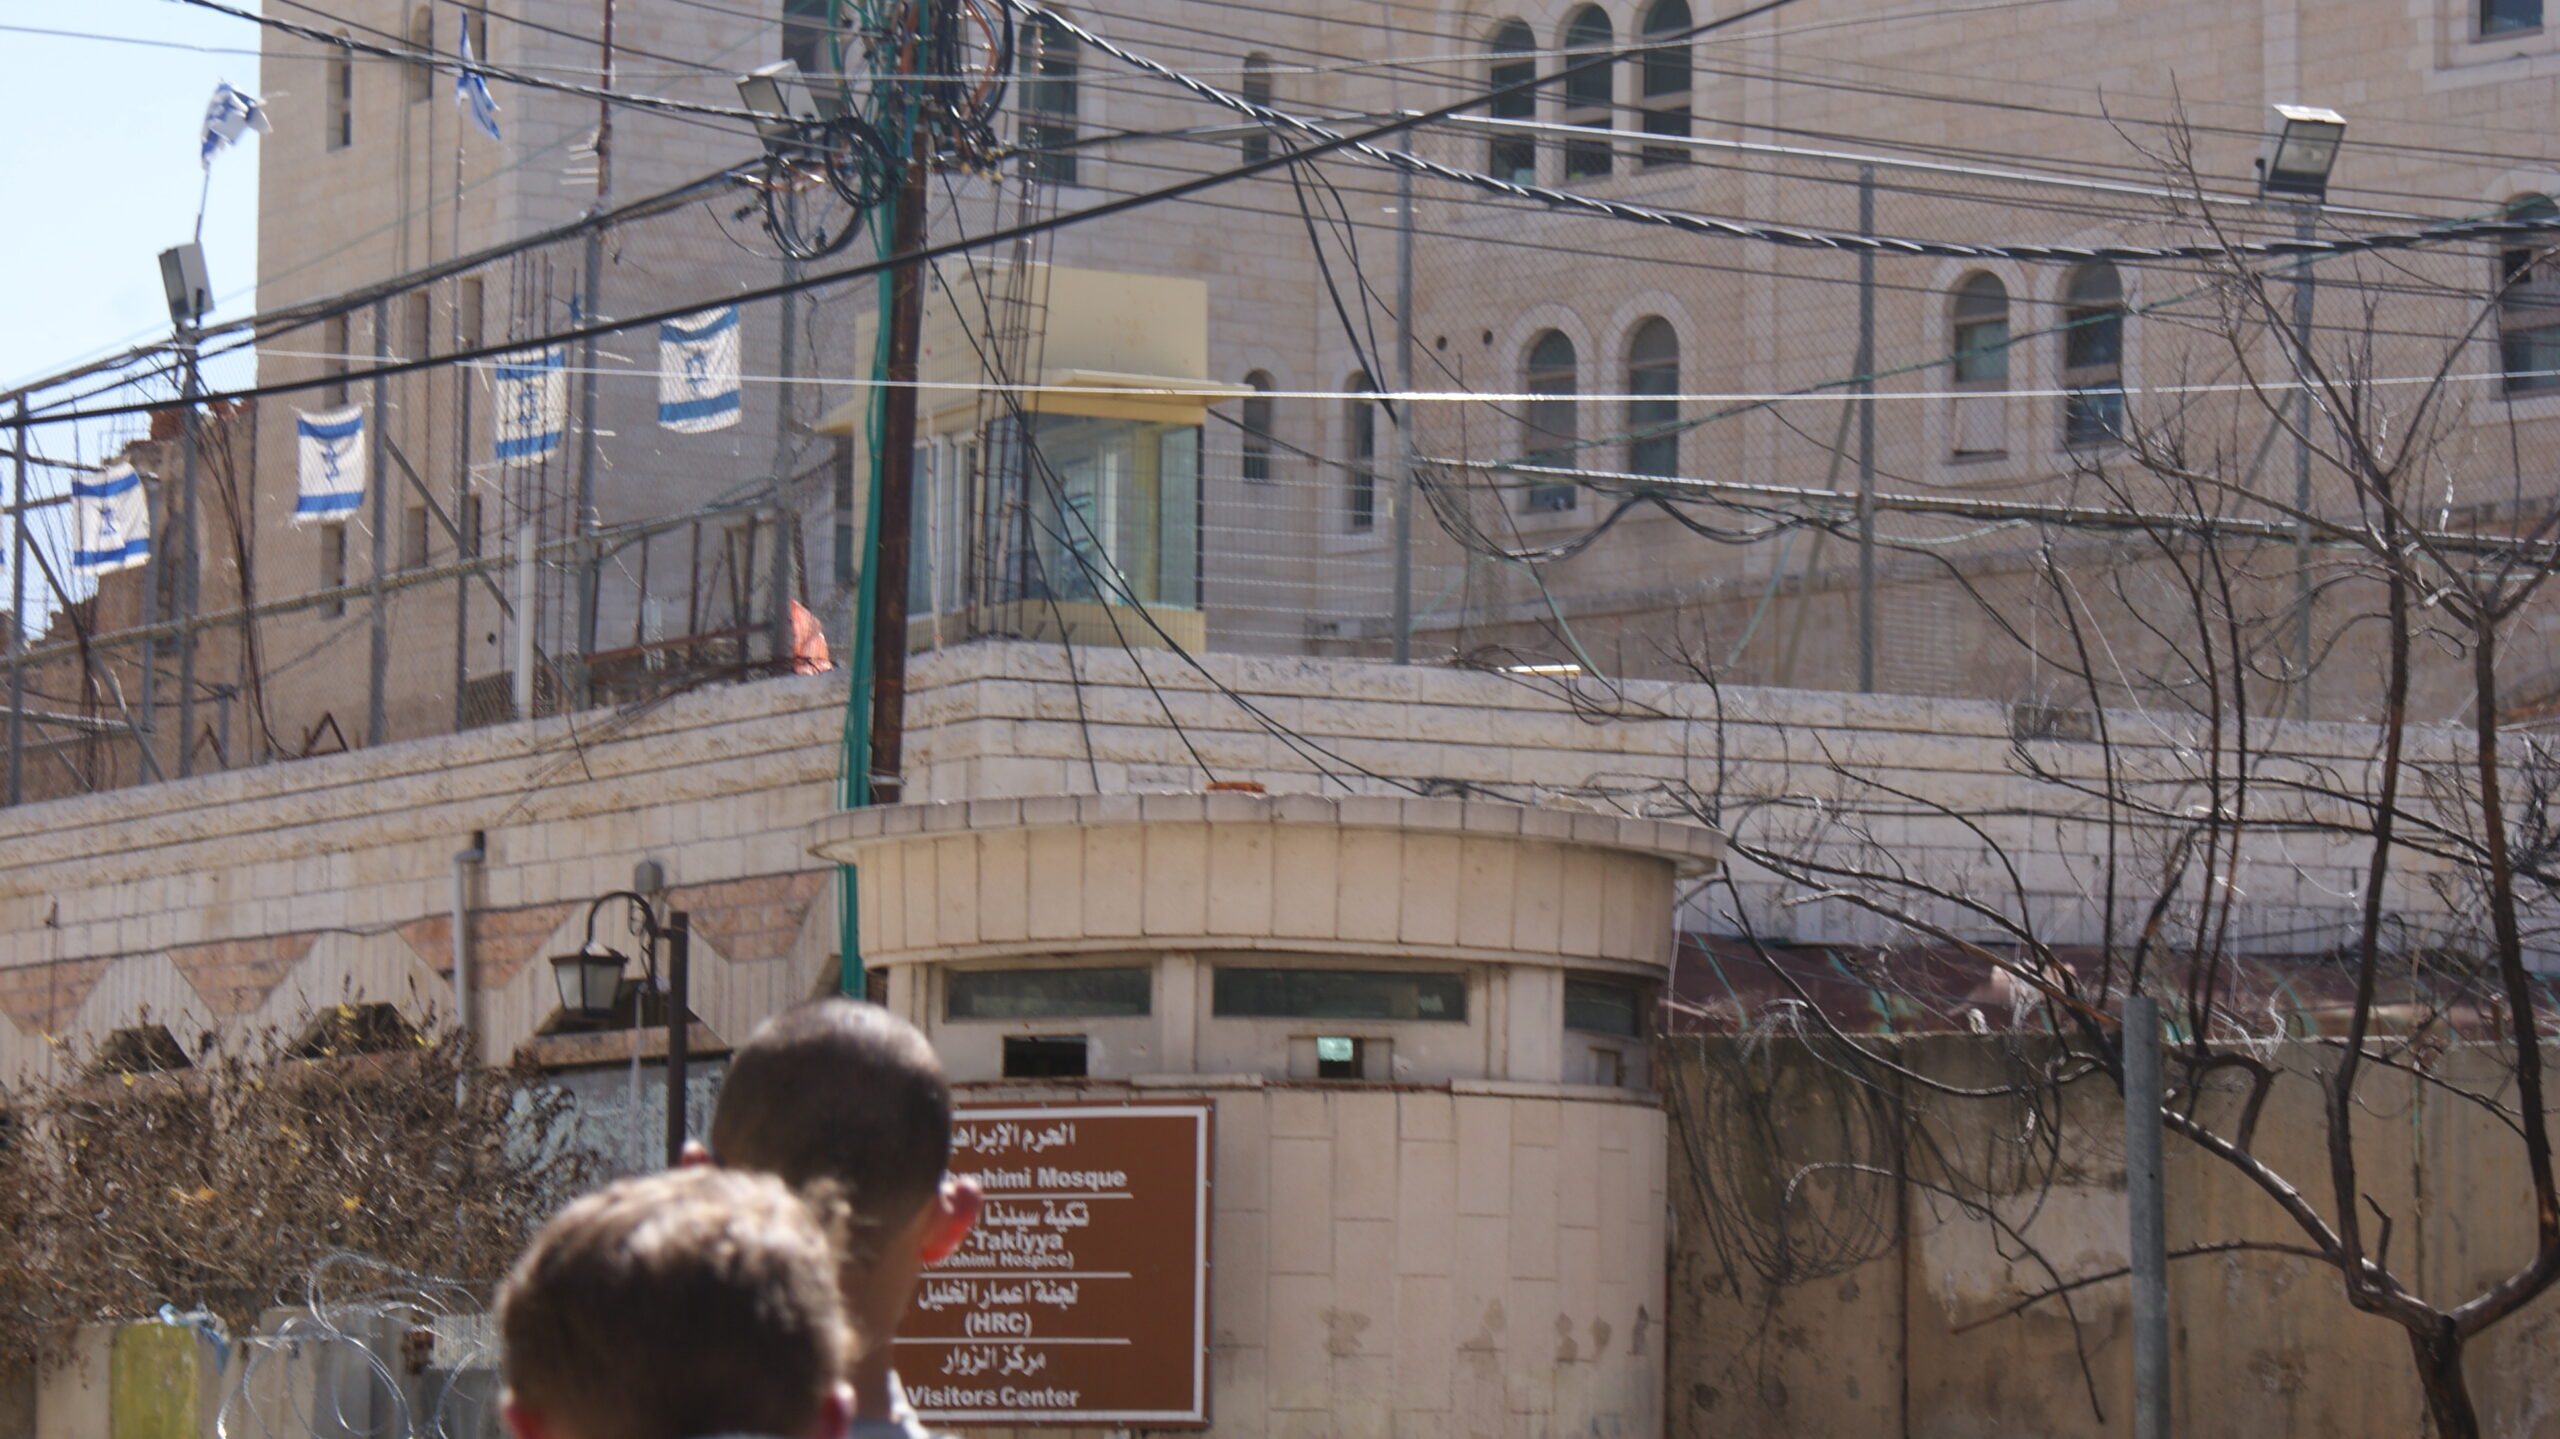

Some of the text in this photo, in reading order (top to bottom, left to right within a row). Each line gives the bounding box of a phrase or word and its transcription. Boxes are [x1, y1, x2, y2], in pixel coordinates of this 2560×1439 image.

[1022, 1121, 1076, 1153] الحرم
[1037, 1166, 1127, 1191] Mosque
[984, 1200, 1040, 1232] سيدنا
[1043, 1199, 1090, 1233] تكية
[1000, 1251, 1074, 1271] Hospice)
[918, 1279, 977, 1312] الخليل
[1035, 1279, 1079, 1311] لجنة
[965, 1311, 1032, 1338] (HRC)
[941, 1345, 1046, 1376] مركز الزوار
[907, 1386, 1080, 1407] Visitors Center
